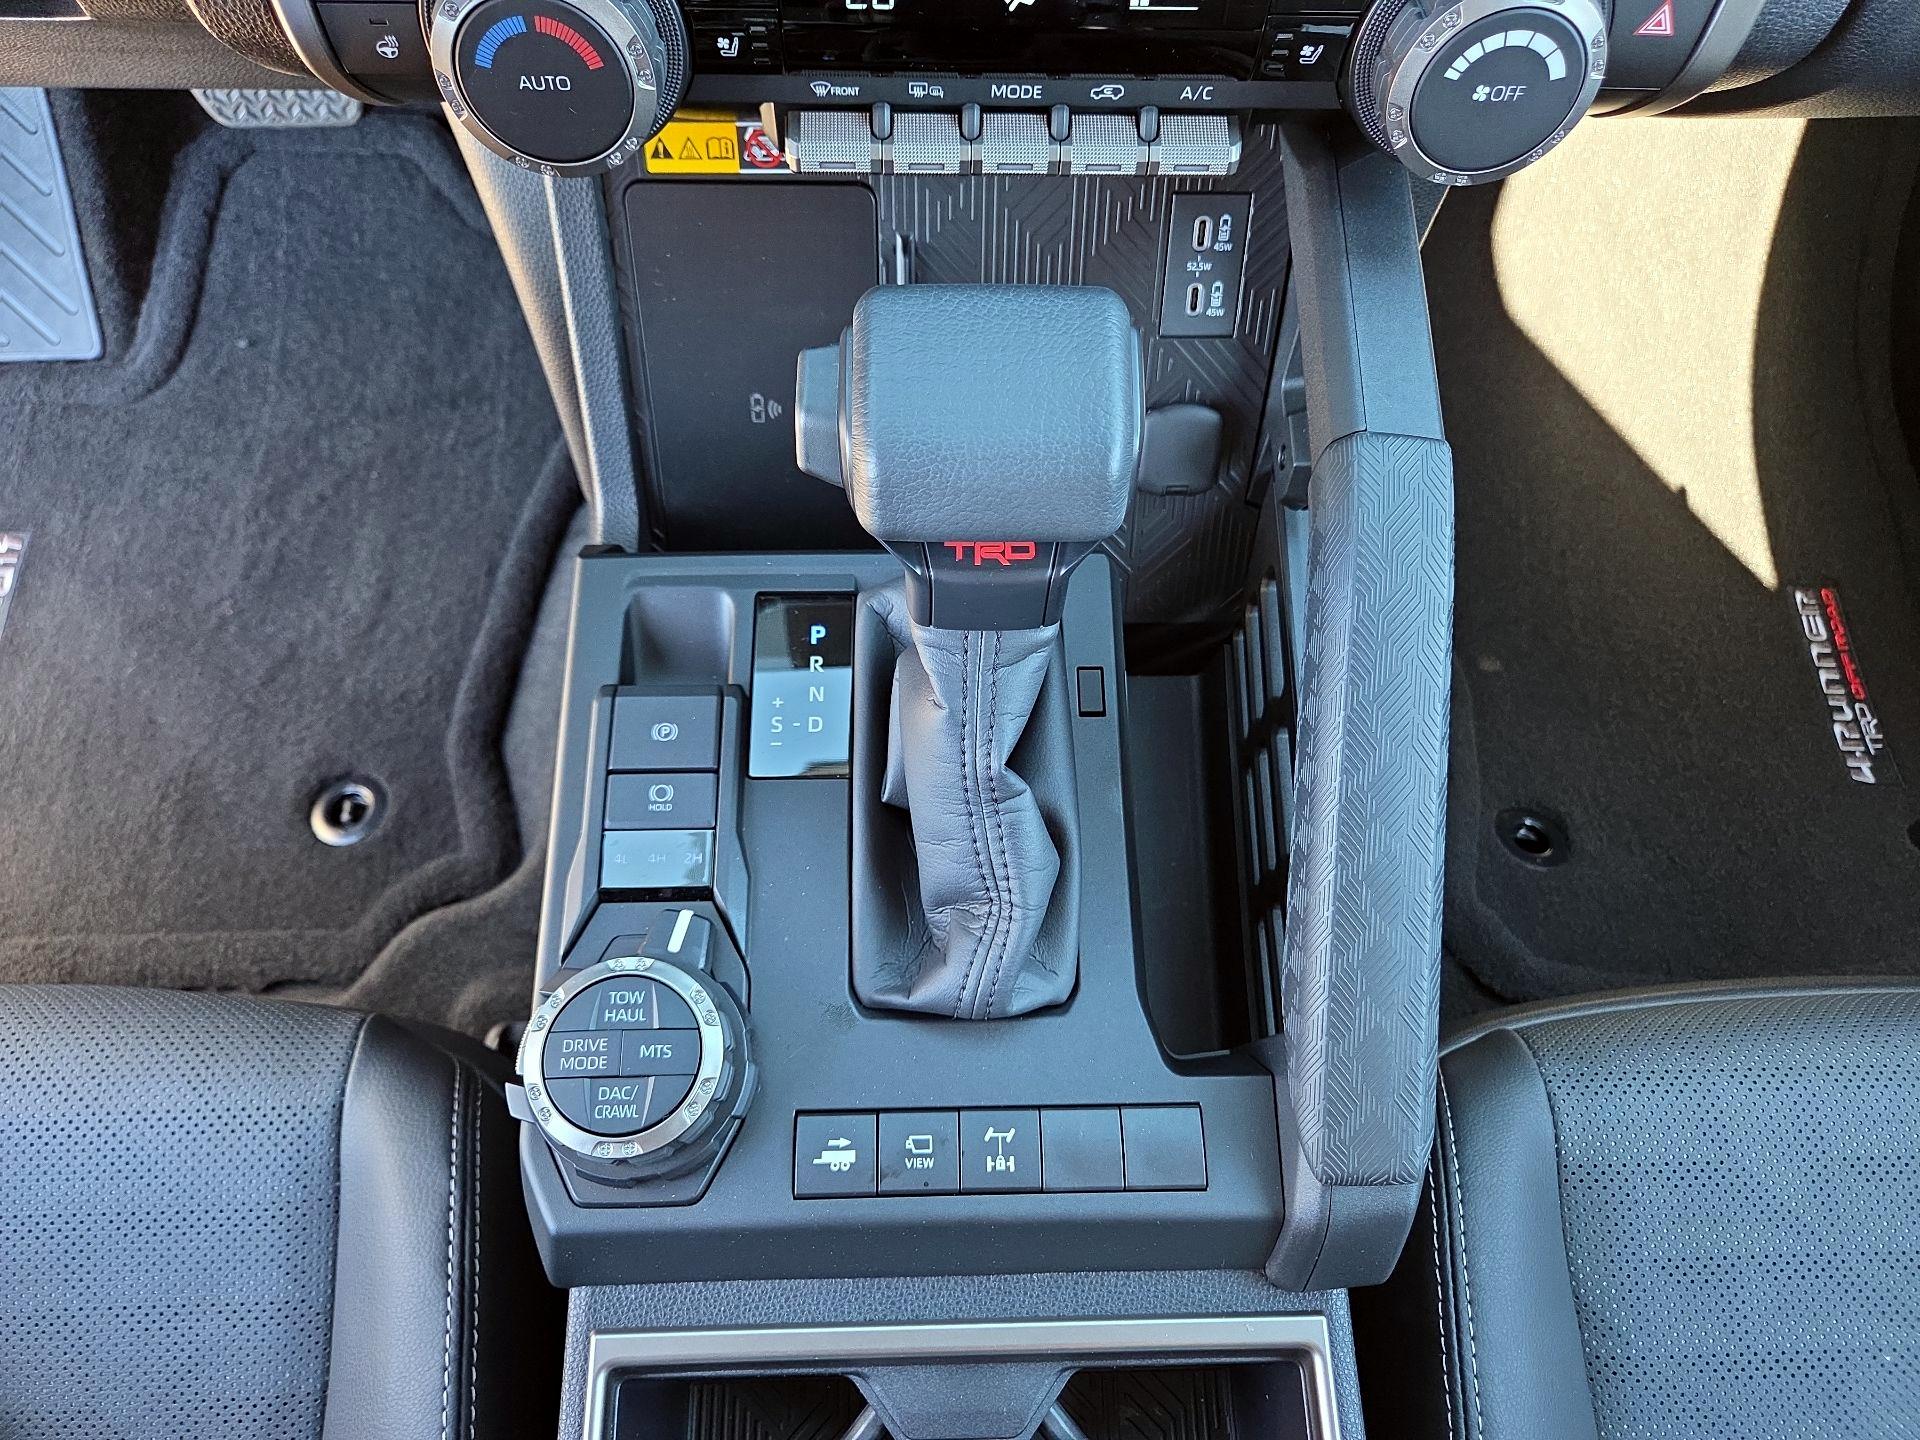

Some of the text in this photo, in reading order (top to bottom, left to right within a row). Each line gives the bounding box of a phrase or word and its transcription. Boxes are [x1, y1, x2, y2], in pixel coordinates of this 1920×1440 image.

[519, 74, 571, 91] AUTO
[830, 86, 860, 97] FRONT
[991, 84, 1042, 99] MODE
[1180, 86, 1214, 101] A/C
[1490, 86, 1526, 102] OFF
[1213, 242, 1233, 252] 45W
[1186, 262, 1212, 271] 52.5W
[1205, 308, 1225, 317] 45W
[943, 541, 1036, 566] TRD
[810, 625, 826, 645] P
[809, 655, 824, 673] R
[809, 686, 824, 702] N
[771, 716, 783, 733] S
[808, 716, 823, 733] D
[648, 803, 673, 812] HOLD
[608, 991, 646, 1005] TOW
[604, 1008, 647, 1022] HAUL
[562, 1038, 608, 1053] DRIVE
[639, 1044, 672, 1059] MTS
[560, 1056, 608, 1071] MODE
[598, 1085, 639, 1101] DAC/
[594, 1104, 639, 1119] CRAWL
[904, 1157, 935, 1170] VIEW
